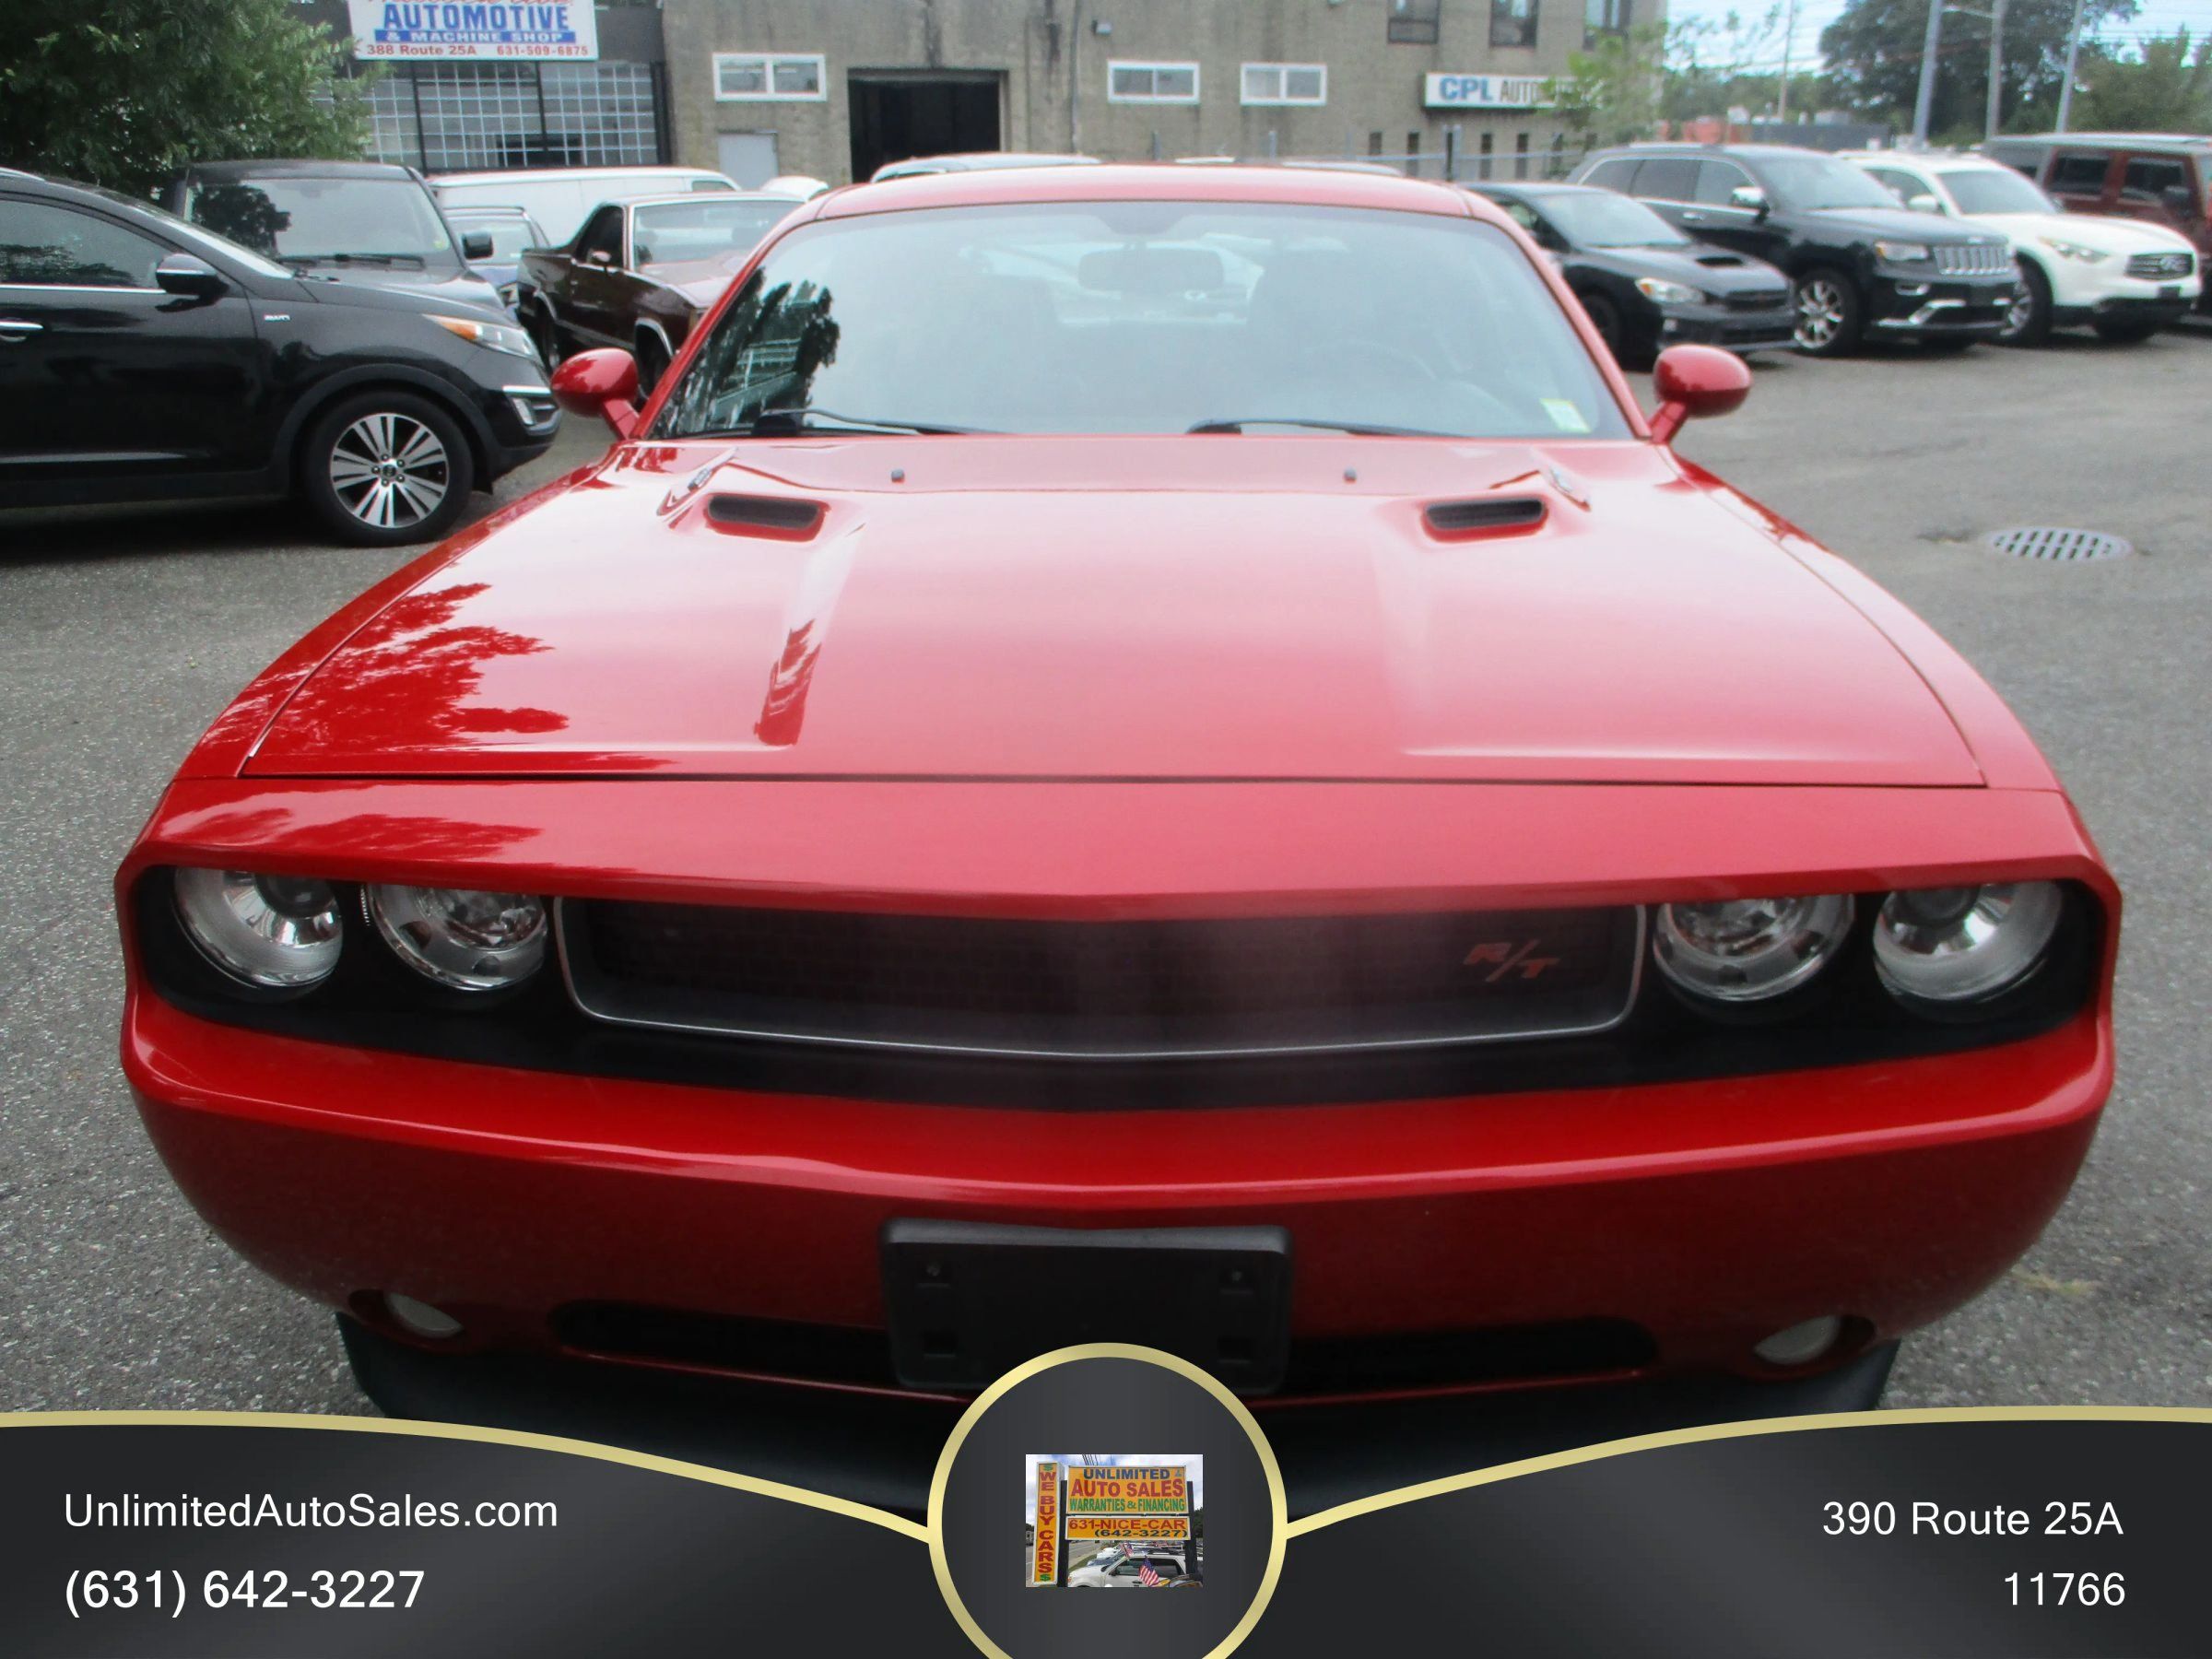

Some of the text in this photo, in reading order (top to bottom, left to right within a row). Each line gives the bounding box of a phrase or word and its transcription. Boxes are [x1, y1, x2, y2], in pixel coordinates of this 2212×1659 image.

[382, 4, 570, 30] AUTOMOTIVE
[385, 31, 563, 42] & MACHINE SHOP
[367, 45, 589, 56] 388 Route 25A 631-509-6875
[1440, 76, 1492, 100] CPL
[1463, 938, 1559, 982] R/T
